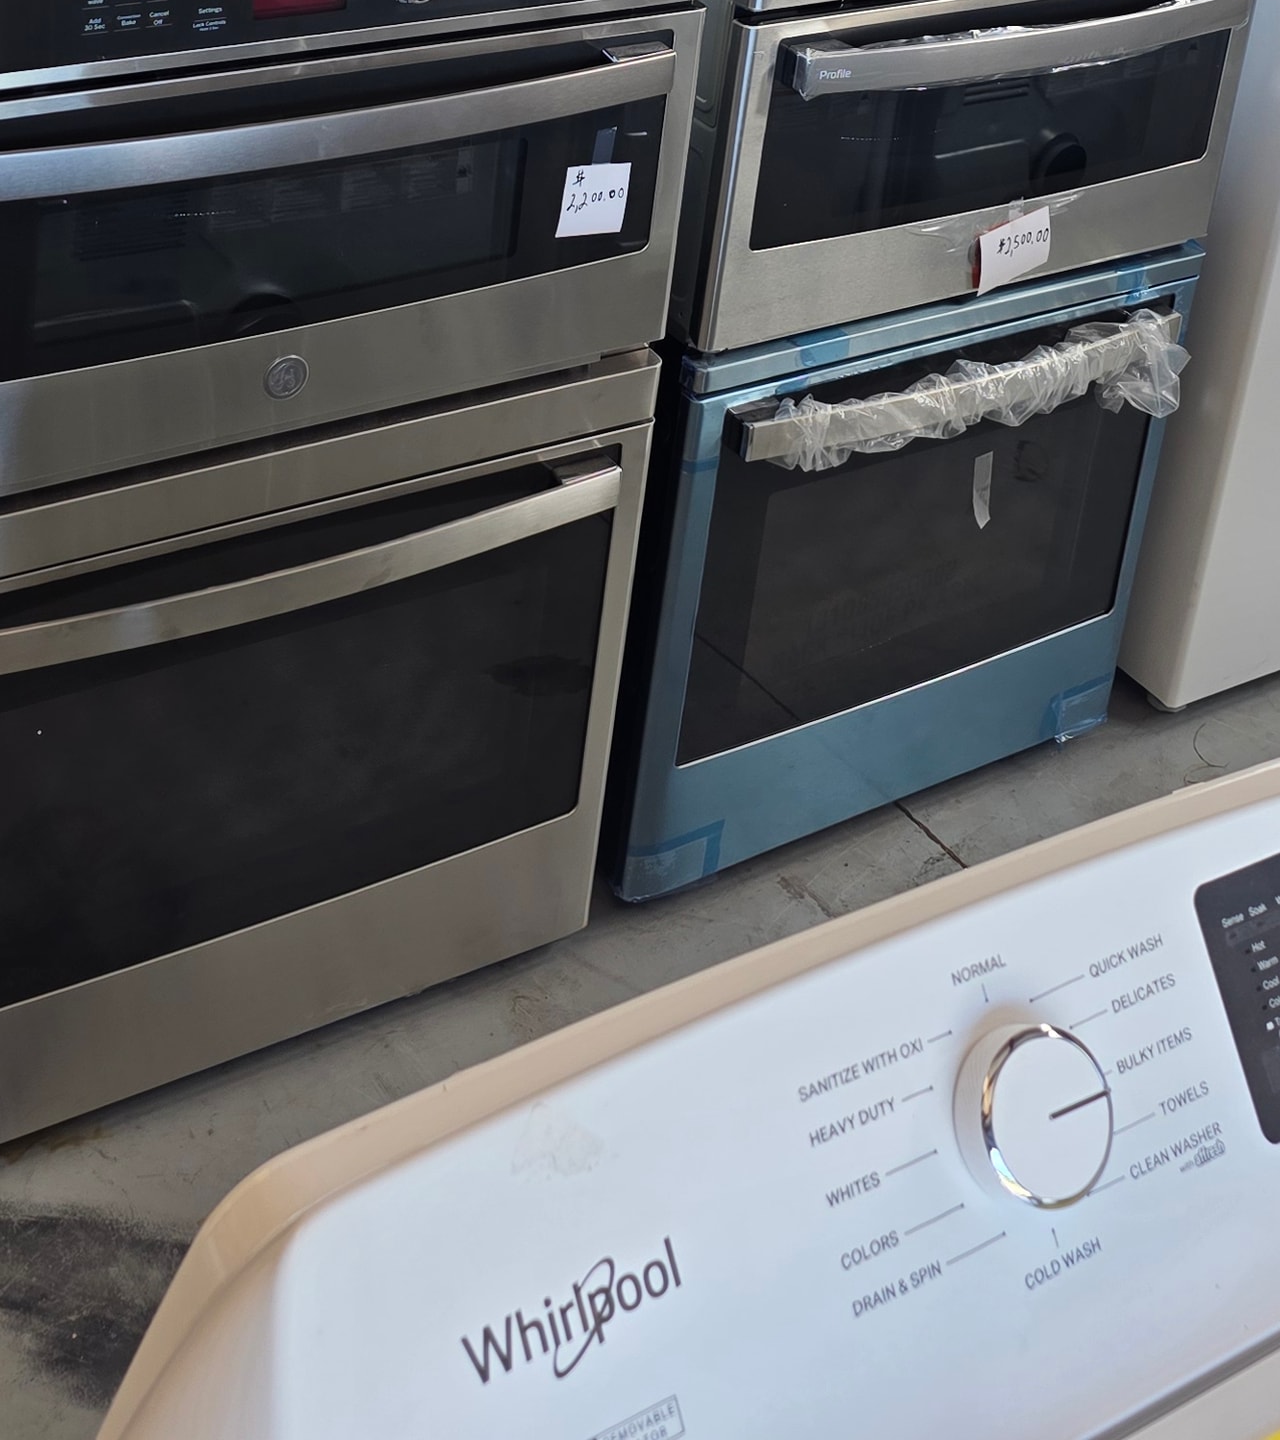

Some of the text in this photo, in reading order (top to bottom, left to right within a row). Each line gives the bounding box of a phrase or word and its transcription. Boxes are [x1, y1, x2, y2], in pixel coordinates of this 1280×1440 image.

[820, 69, 852, 79] Profile
[566, 187, 624, 213] 2,200.00
[1221, 912, 1245, 928] Sense
[1248, 902, 1268, 917] Soak
[1088, 934, 1164, 980] QUICK WASH
[1250, 939, 1266, 952] Hot
[1257, 956, 1279, 971] Warm
[950, 954, 1007, 987] NORMAL
[1262, 975, 1280, 990] Cool
[1110, 973, 1176, 1014] DELICATES
[797, 1037, 924, 1103] SANITIZE WITH OXI
[1115, 1026, 1193, 1075] BULKY ITEMS
[1158, 1080, 1210, 1118] TOWELS
[807, 1096, 896, 1148] HEAVY DUTY
[1128, 1120, 1223, 1181] CLEAN WASHER
[825, 1172, 881, 1208] WHITES
[839, 1230, 900, 1271] COLORS
[1023, 1236, 1103, 1291] COLD WASH
[461, 1234, 682, 1379] Whirlpool
[851, 1260, 944, 1318] DRAIN & SPIN
